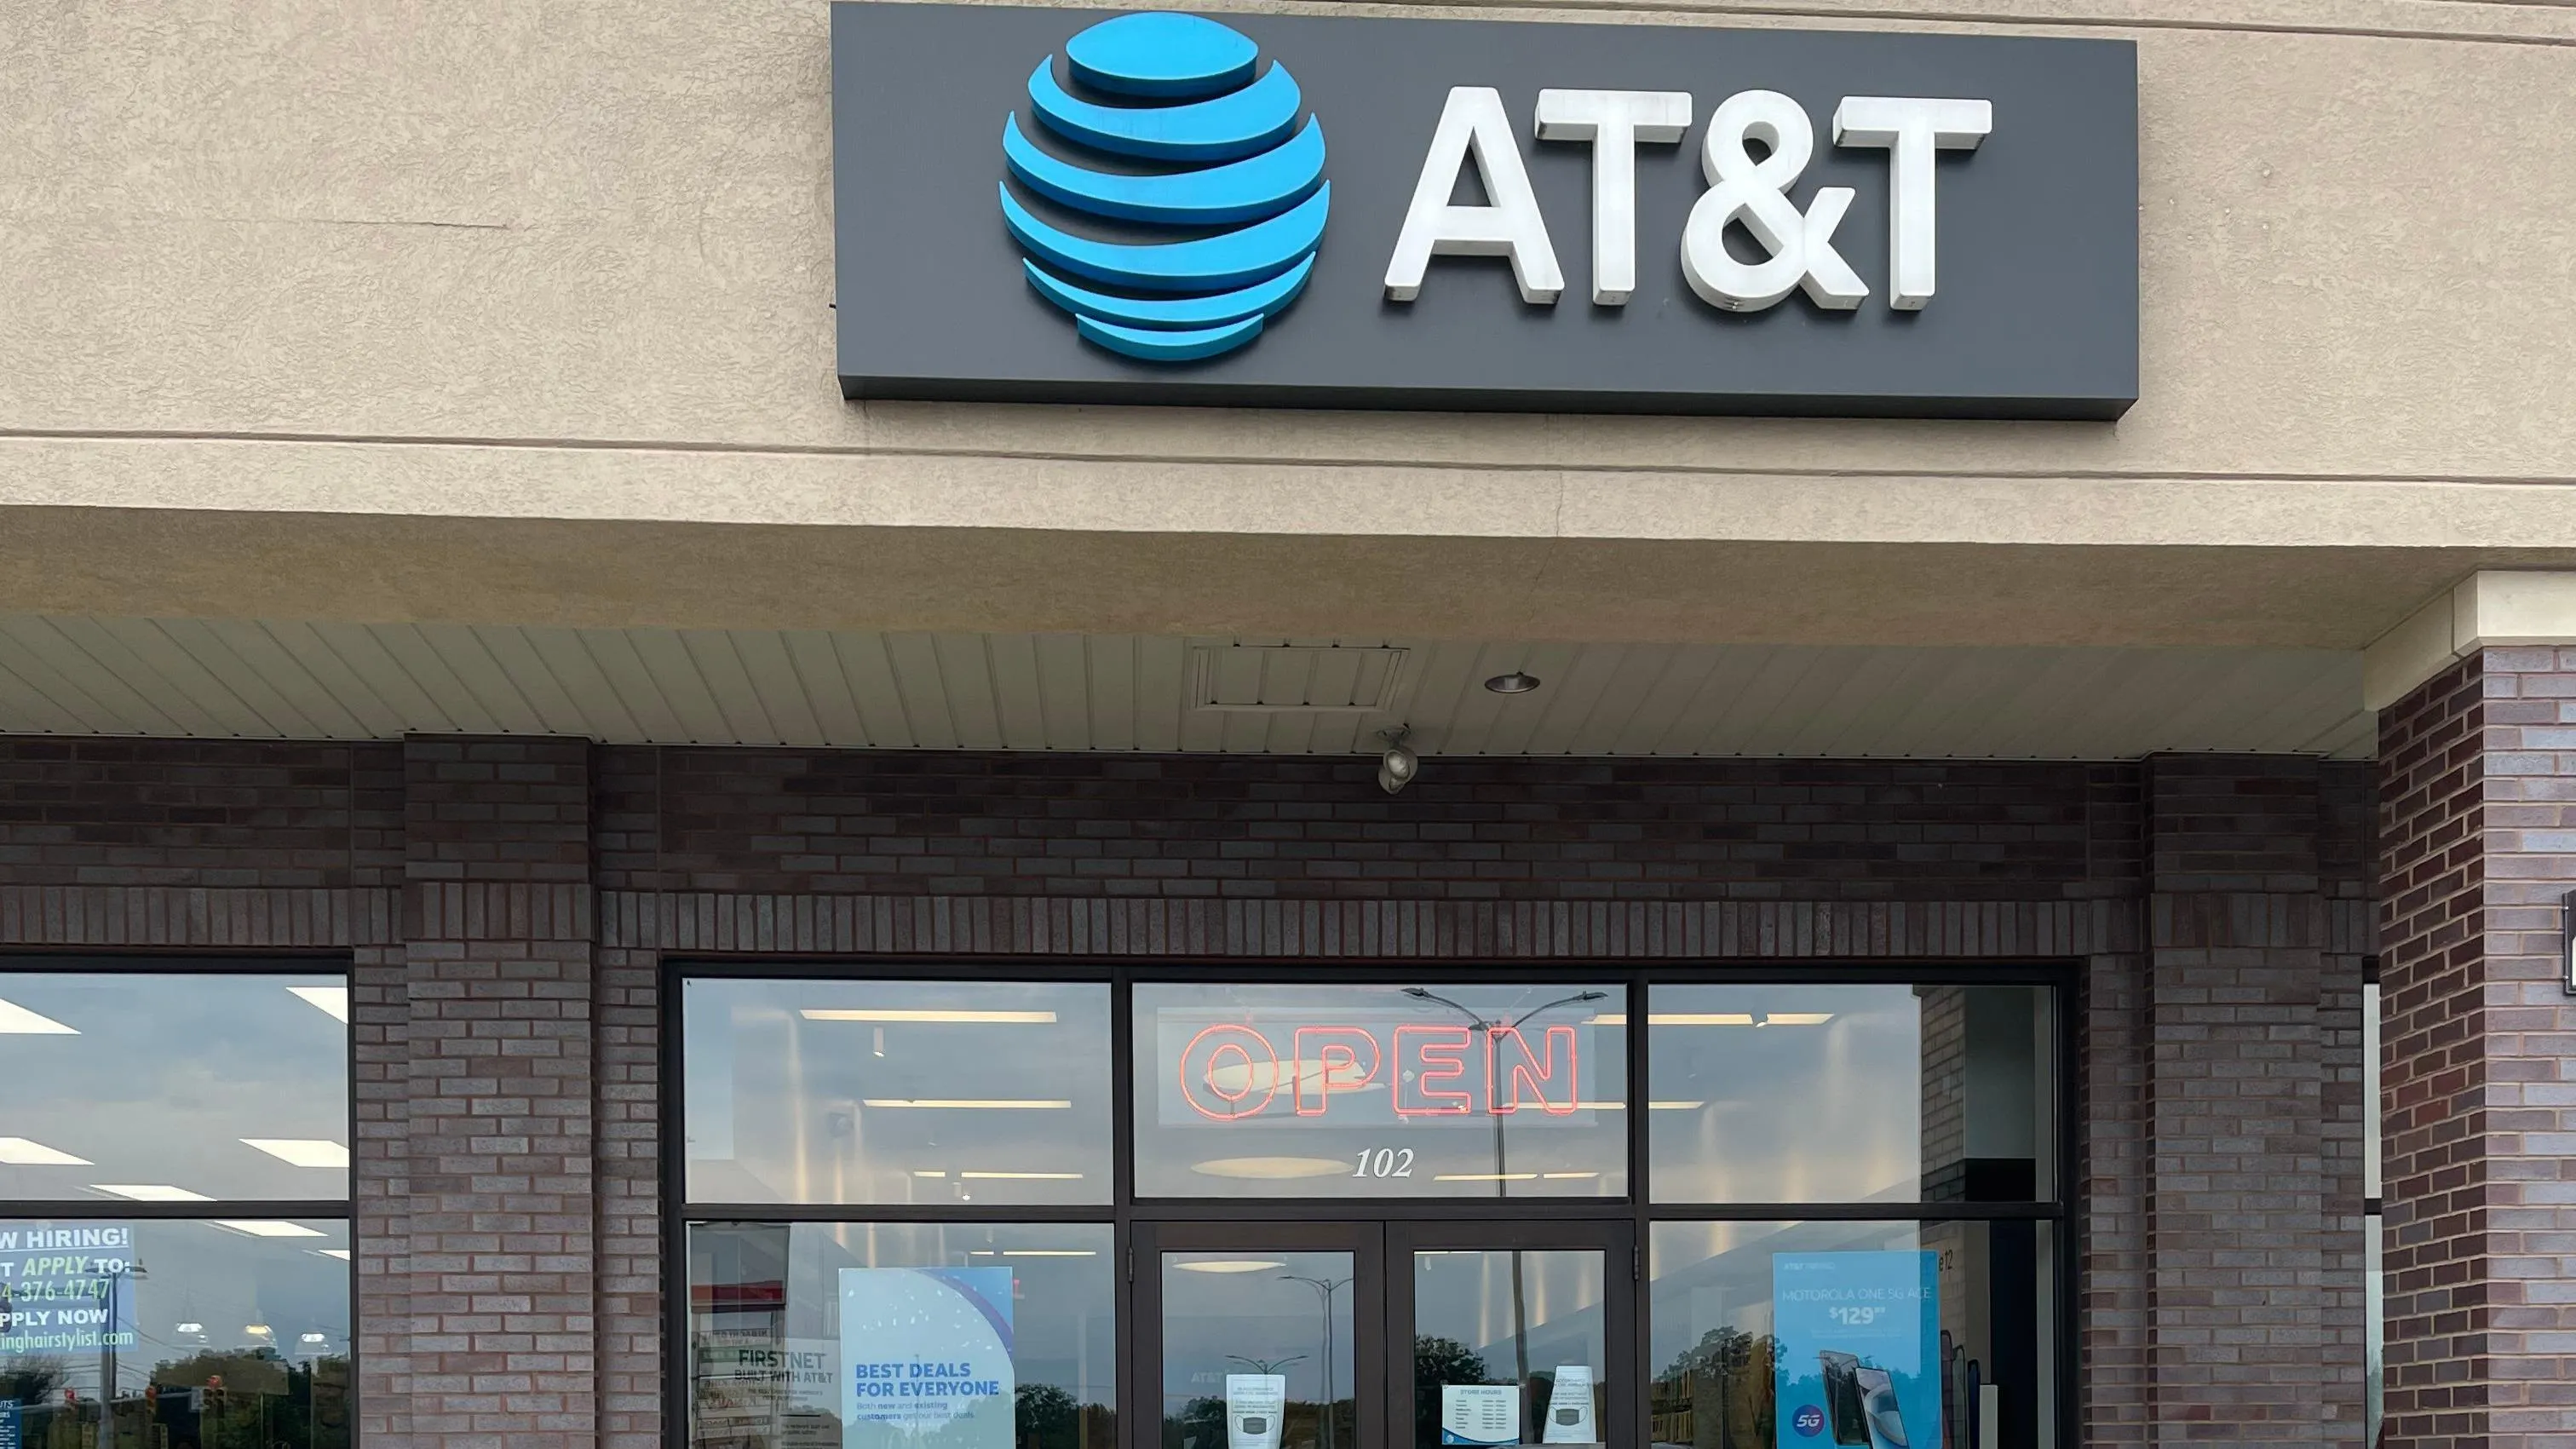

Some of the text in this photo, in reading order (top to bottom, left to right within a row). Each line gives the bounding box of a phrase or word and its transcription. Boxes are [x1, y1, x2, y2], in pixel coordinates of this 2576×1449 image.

[1383, 86, 1992, 313] AT&T
[1180, 1024, 1578, 1121] OPEN
[1352, 1147, 1416, 1179] 102
[26, 1228, 129, 1249] HIRING!
[22, 1256, 89, 1276] APPLY
[94, 1258, 130, 1274] TO:
[1782, 1286, 1932, 1302] MOTOROLA ONE 5G ACE
[58, 1308, 109, 1325] NOW
[739, 1349, 827, 1369] FIRSTNET
[734, 1370, 833, 1383] BUILT WITH AT&T
[856, 1363, 971, 1378] BEST DEALS
[857, 1381, 999, 1397] FOR EVERYONE
[914, 1401, 948, 1411] existing
[1797, 1414, 1820, 1428] 5G
